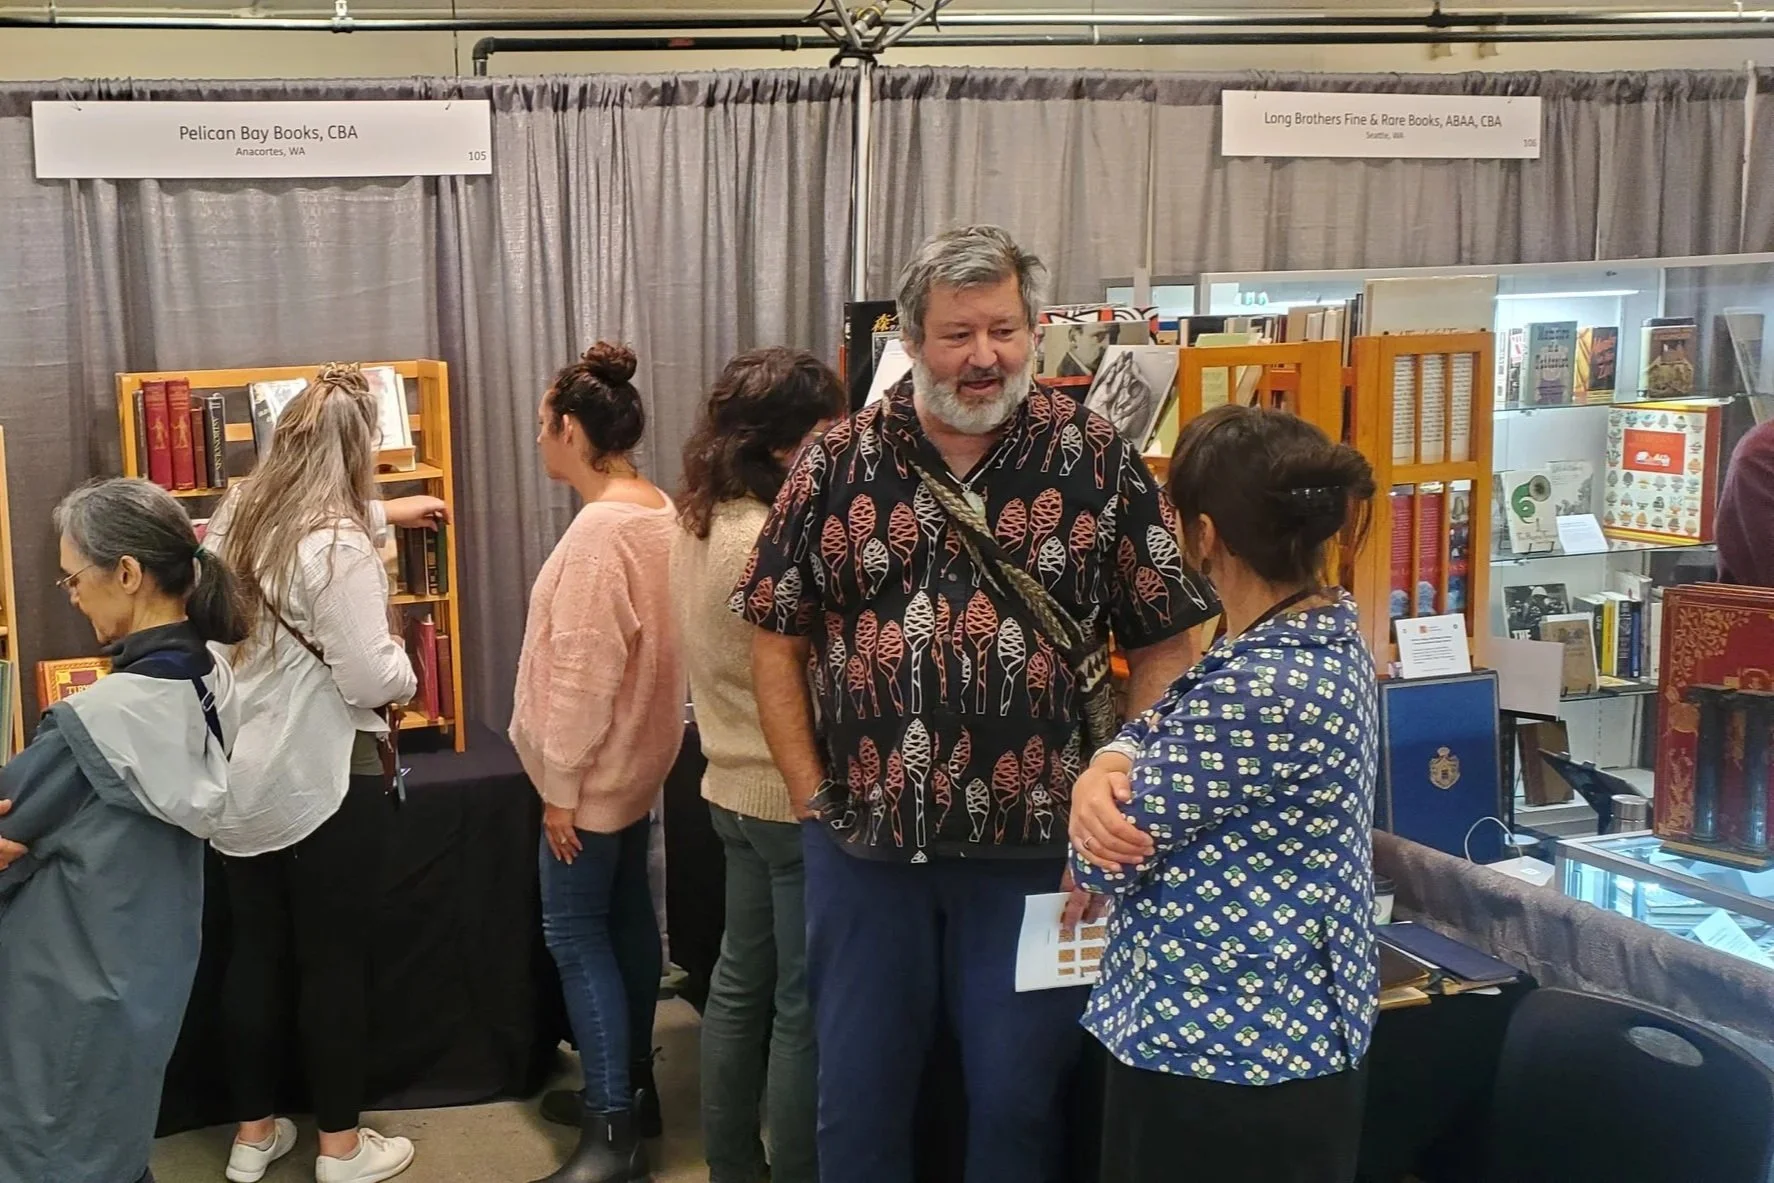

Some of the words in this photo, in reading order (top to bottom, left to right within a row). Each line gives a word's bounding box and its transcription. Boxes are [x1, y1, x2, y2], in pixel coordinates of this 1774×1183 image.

[1264, 112, 1292, 127] Long
[1295, 112, 1342, 126] Brothers
[1344, 113, 1367, 126] Fine
[1370, 114, 1378, 126] &
[1381, 114, 1406, 126] Rare
[1408, 114, 1443, 128] Books,
[1446, 115, 1478, 129] ABAA,
[1481, 116, 1502, 128] CBA
[179, 125, 236, 141] Pelican
[241, 125, 269, 144] Bay
[274, 125, 323, 142] Books,
[328, 125, 358, 140] CBA
[235, 147, 286, 157] Anacortes,
[289, 147, 305, 156] WA
[468, 151, 486, 161] 105
